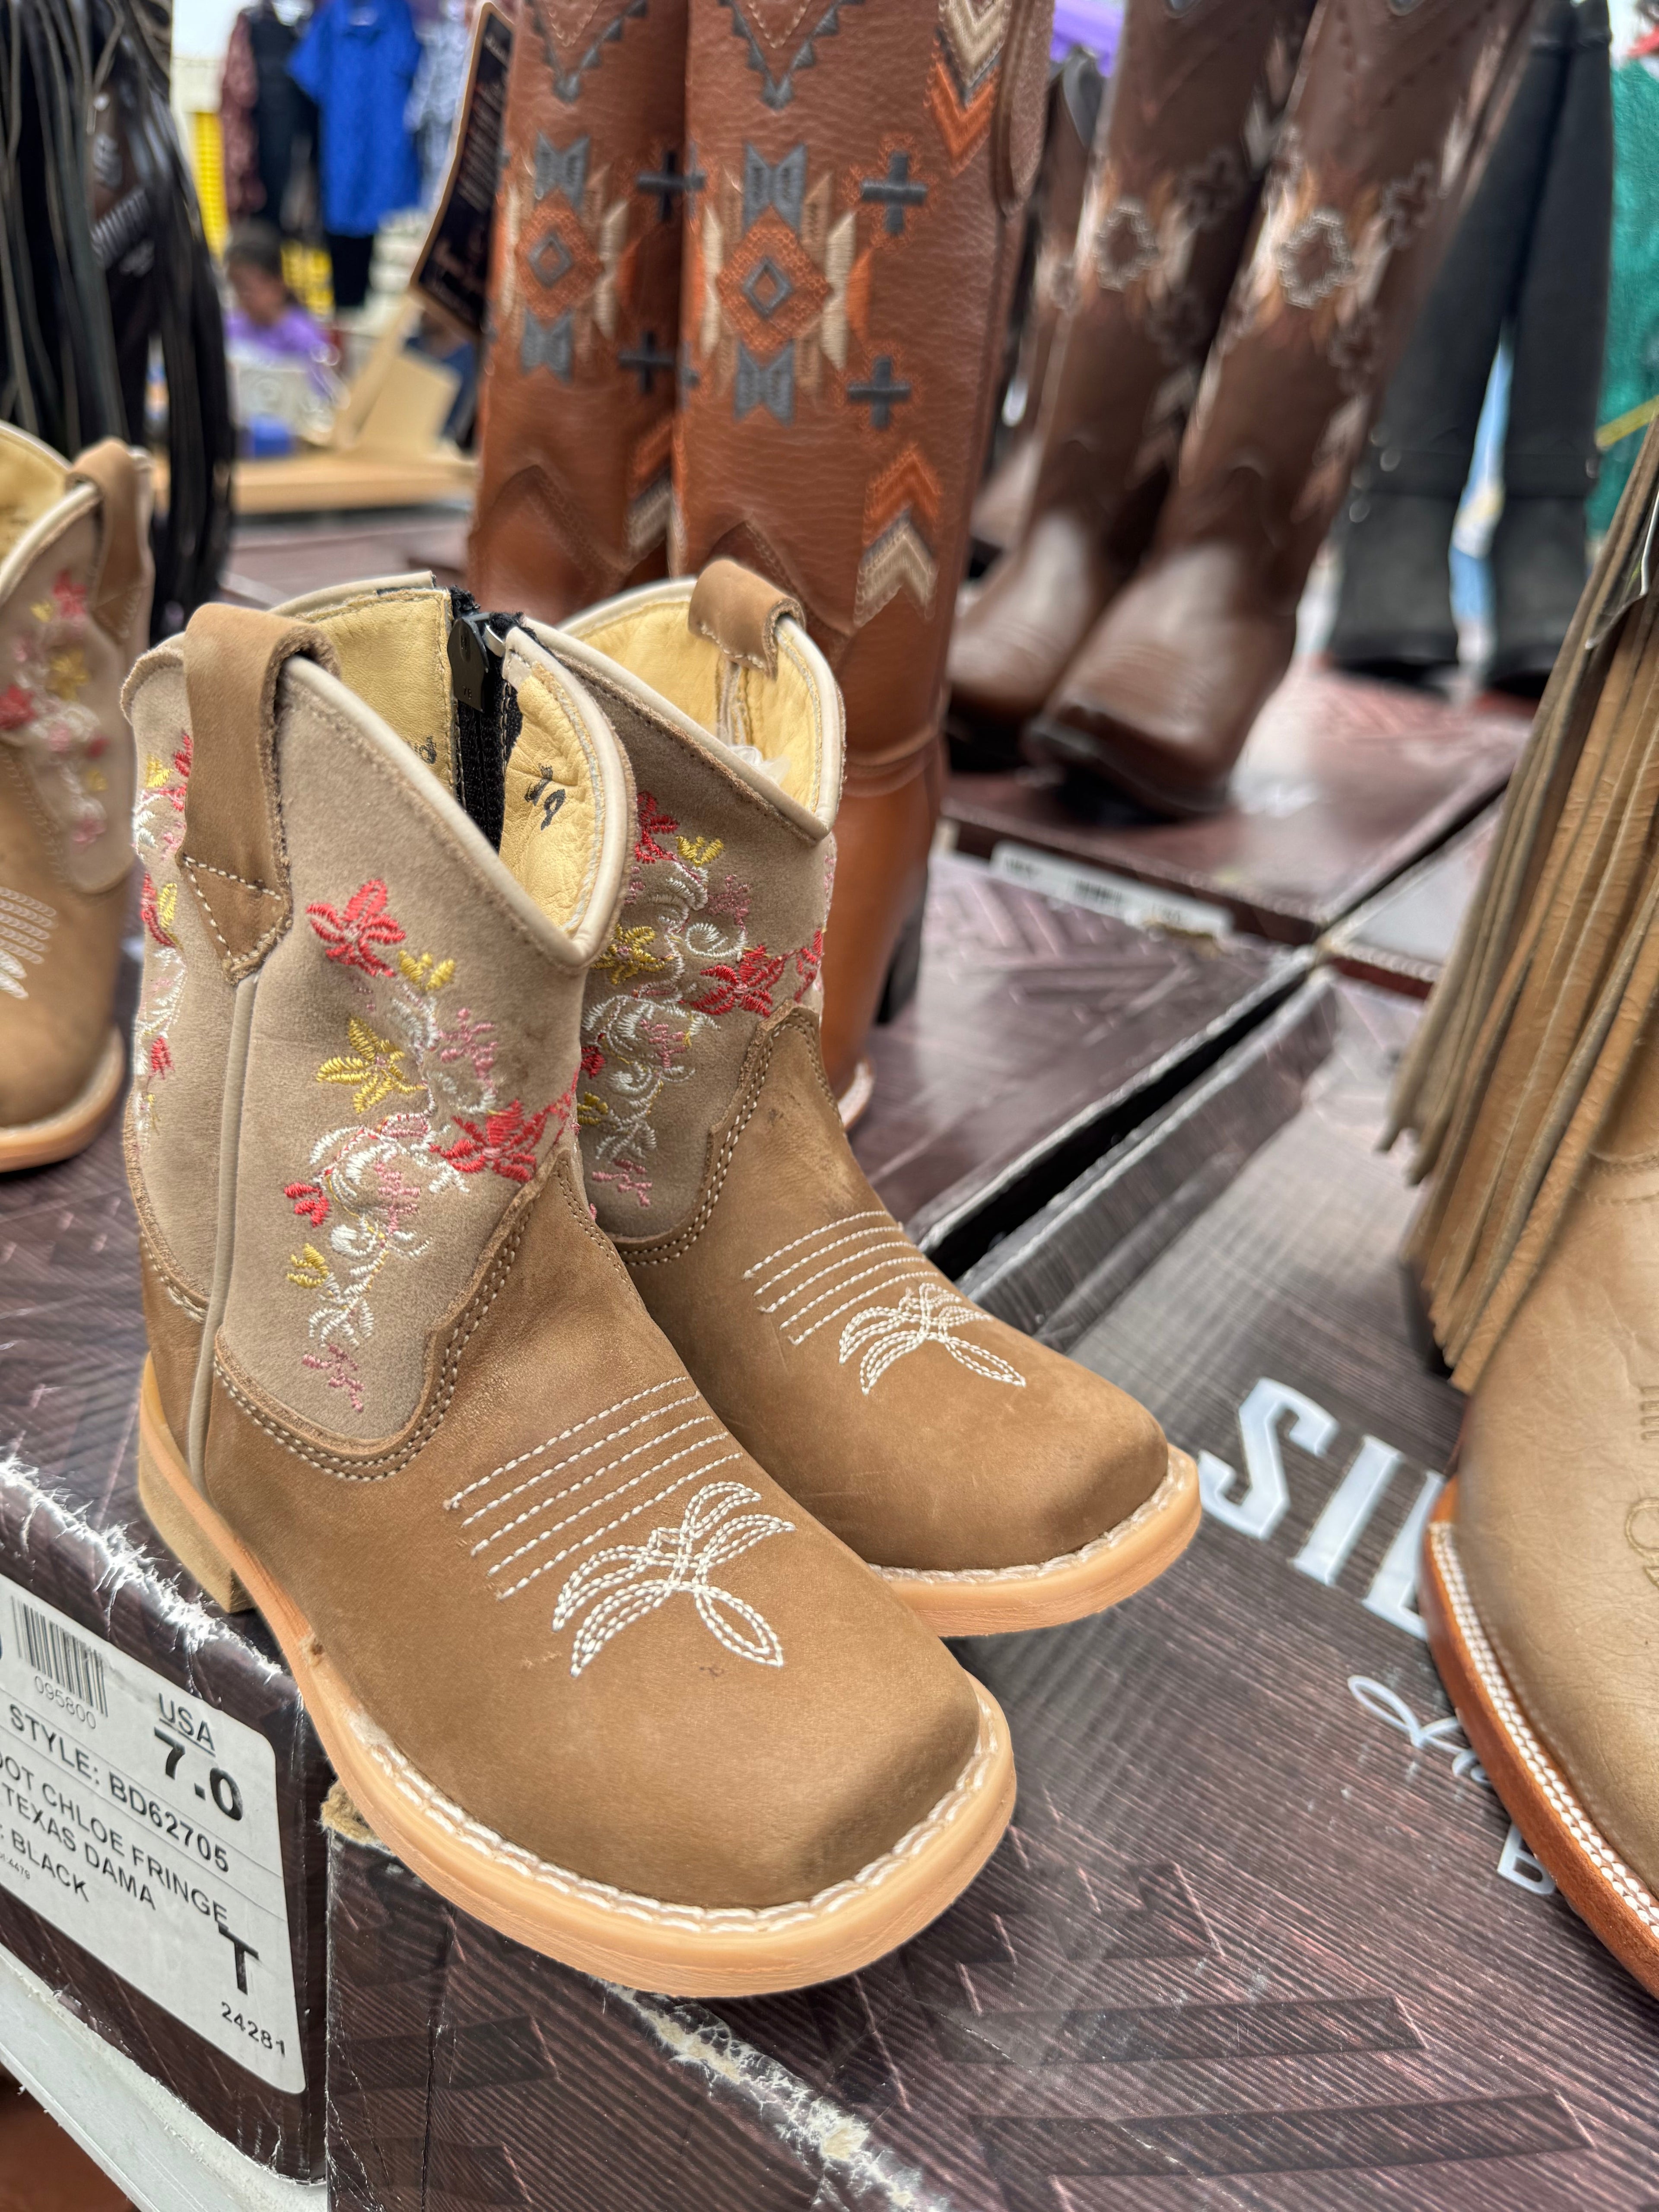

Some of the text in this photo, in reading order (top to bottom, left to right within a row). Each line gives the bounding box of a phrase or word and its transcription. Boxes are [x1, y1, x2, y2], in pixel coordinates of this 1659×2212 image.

[35, 1675, 96, 1729] 095800
[159, 1692, 215, 1751] USA
[10, 1703, 229, 1872] STYLE: BD62705
[154, 1726, 243, 1821] 7.0
[0, 1751, 227, 1926] OT CHLOE FRINGE
[2, 1781, 156, 1911] TEXAS DAMA
[11, 1827, 90, 1903] BLACK
[217, 1922, 259, 1996] T
[221, 2001, 286, 2058] 24281
